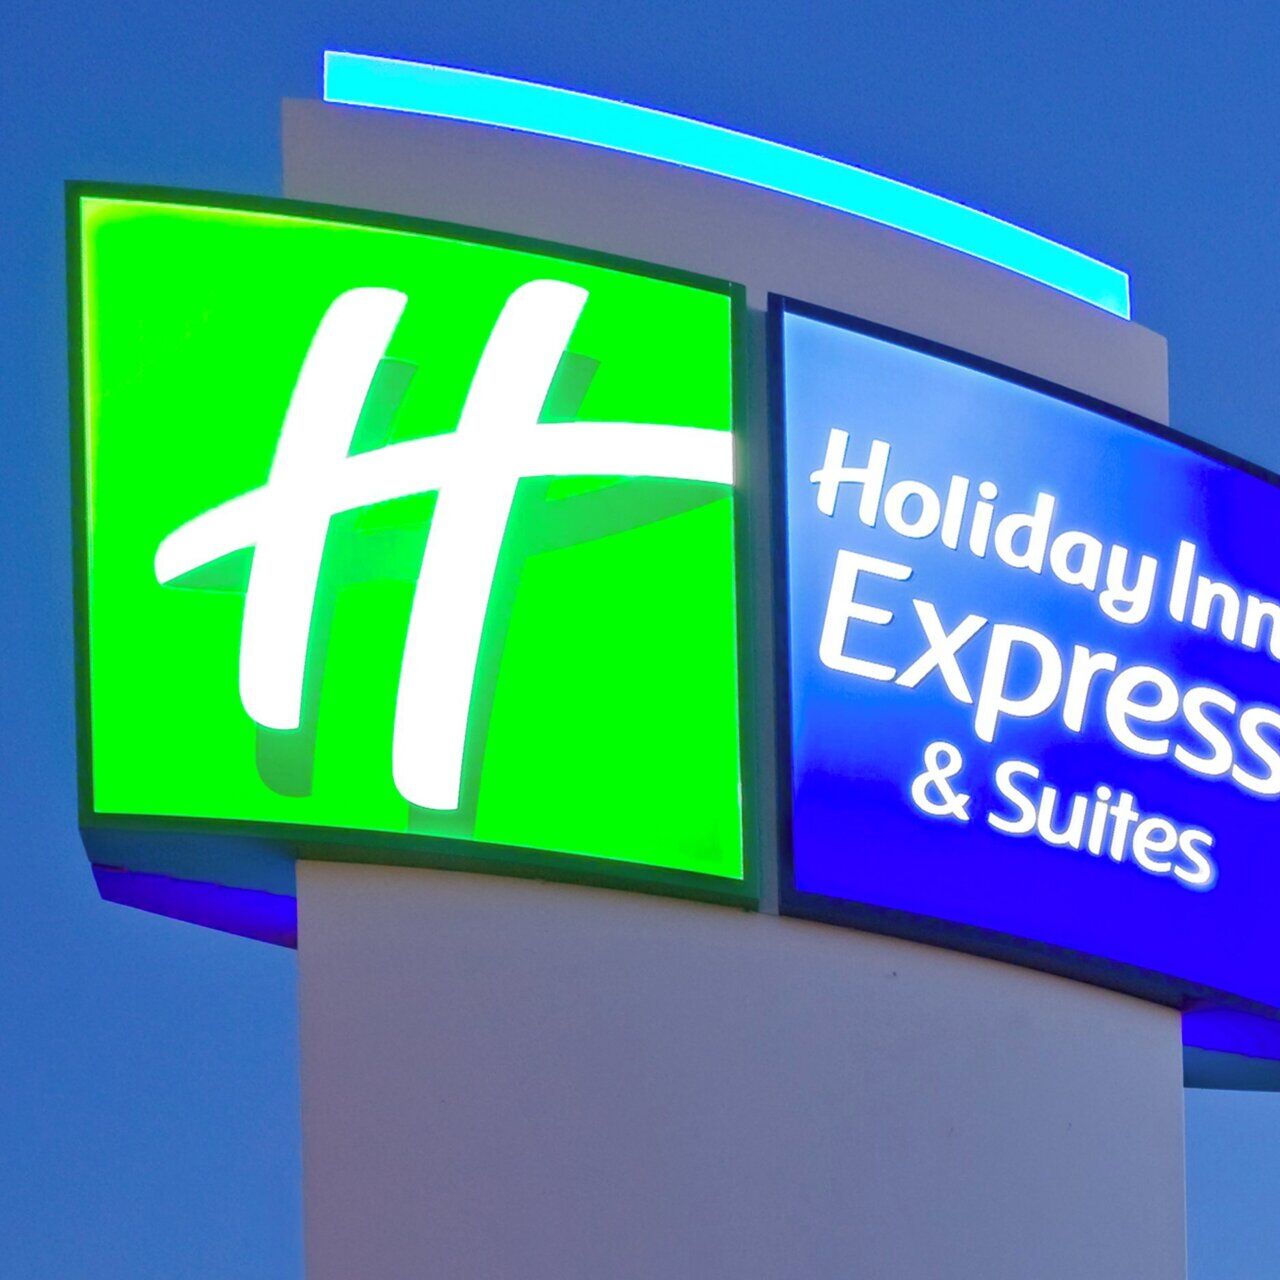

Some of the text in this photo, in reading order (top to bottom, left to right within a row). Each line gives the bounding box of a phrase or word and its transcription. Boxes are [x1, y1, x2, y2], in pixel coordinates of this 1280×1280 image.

[809, 427, 1158, 624] Holiday
[911, 740, 1215, 887] & Suites
